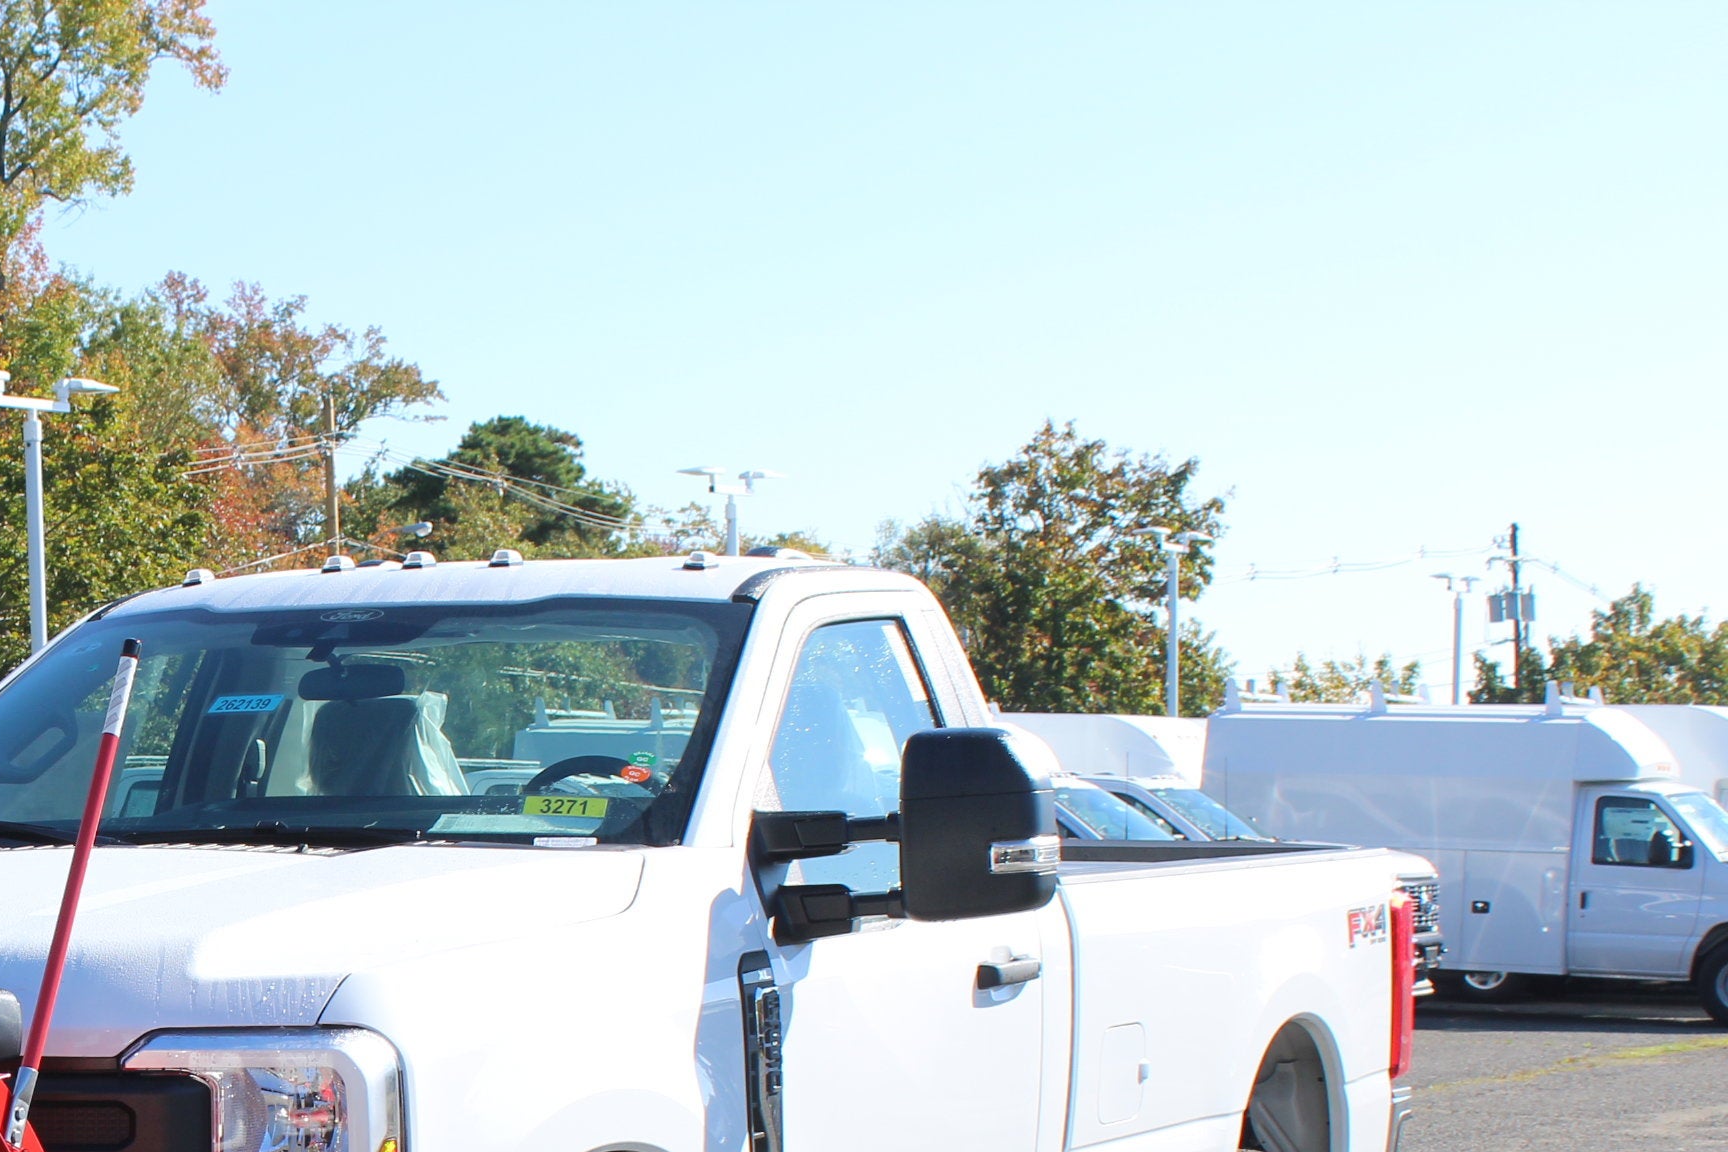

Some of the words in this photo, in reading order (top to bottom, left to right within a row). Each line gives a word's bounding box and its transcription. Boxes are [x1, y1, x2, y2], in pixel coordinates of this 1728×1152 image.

[329, 610, 374, 622] Ford
[215, 698, 272, 711] 262139
[539, 798, 589, 815] 3271
[1346, 903, 1387, 949] FX4
